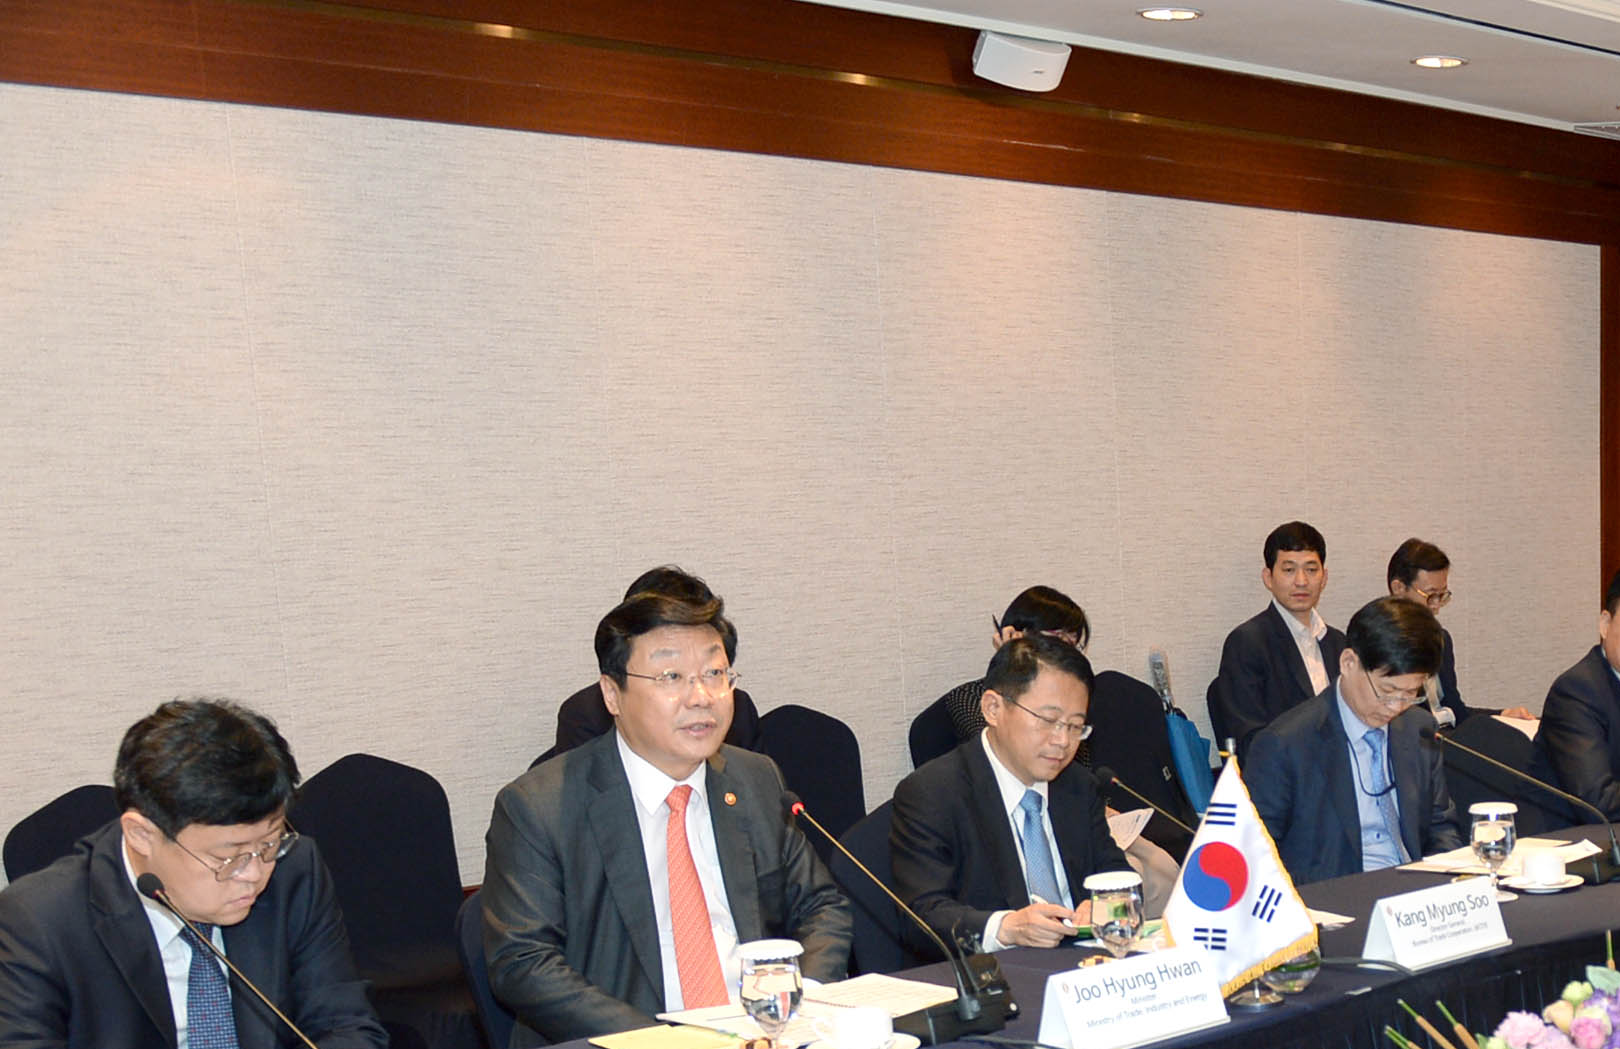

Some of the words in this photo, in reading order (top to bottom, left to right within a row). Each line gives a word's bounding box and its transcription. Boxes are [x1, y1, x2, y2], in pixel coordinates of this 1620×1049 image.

[1394, 909, 1428, 928] Kang
[1426, 899, 1468, 922] Myung
[1466, 894, 1490, 910] Soo
[1074, 985, 1102, 1004] Joo
[1102, 970, 1158, 998] Hyung
[1156, 960, 1203, 983] Hwan
